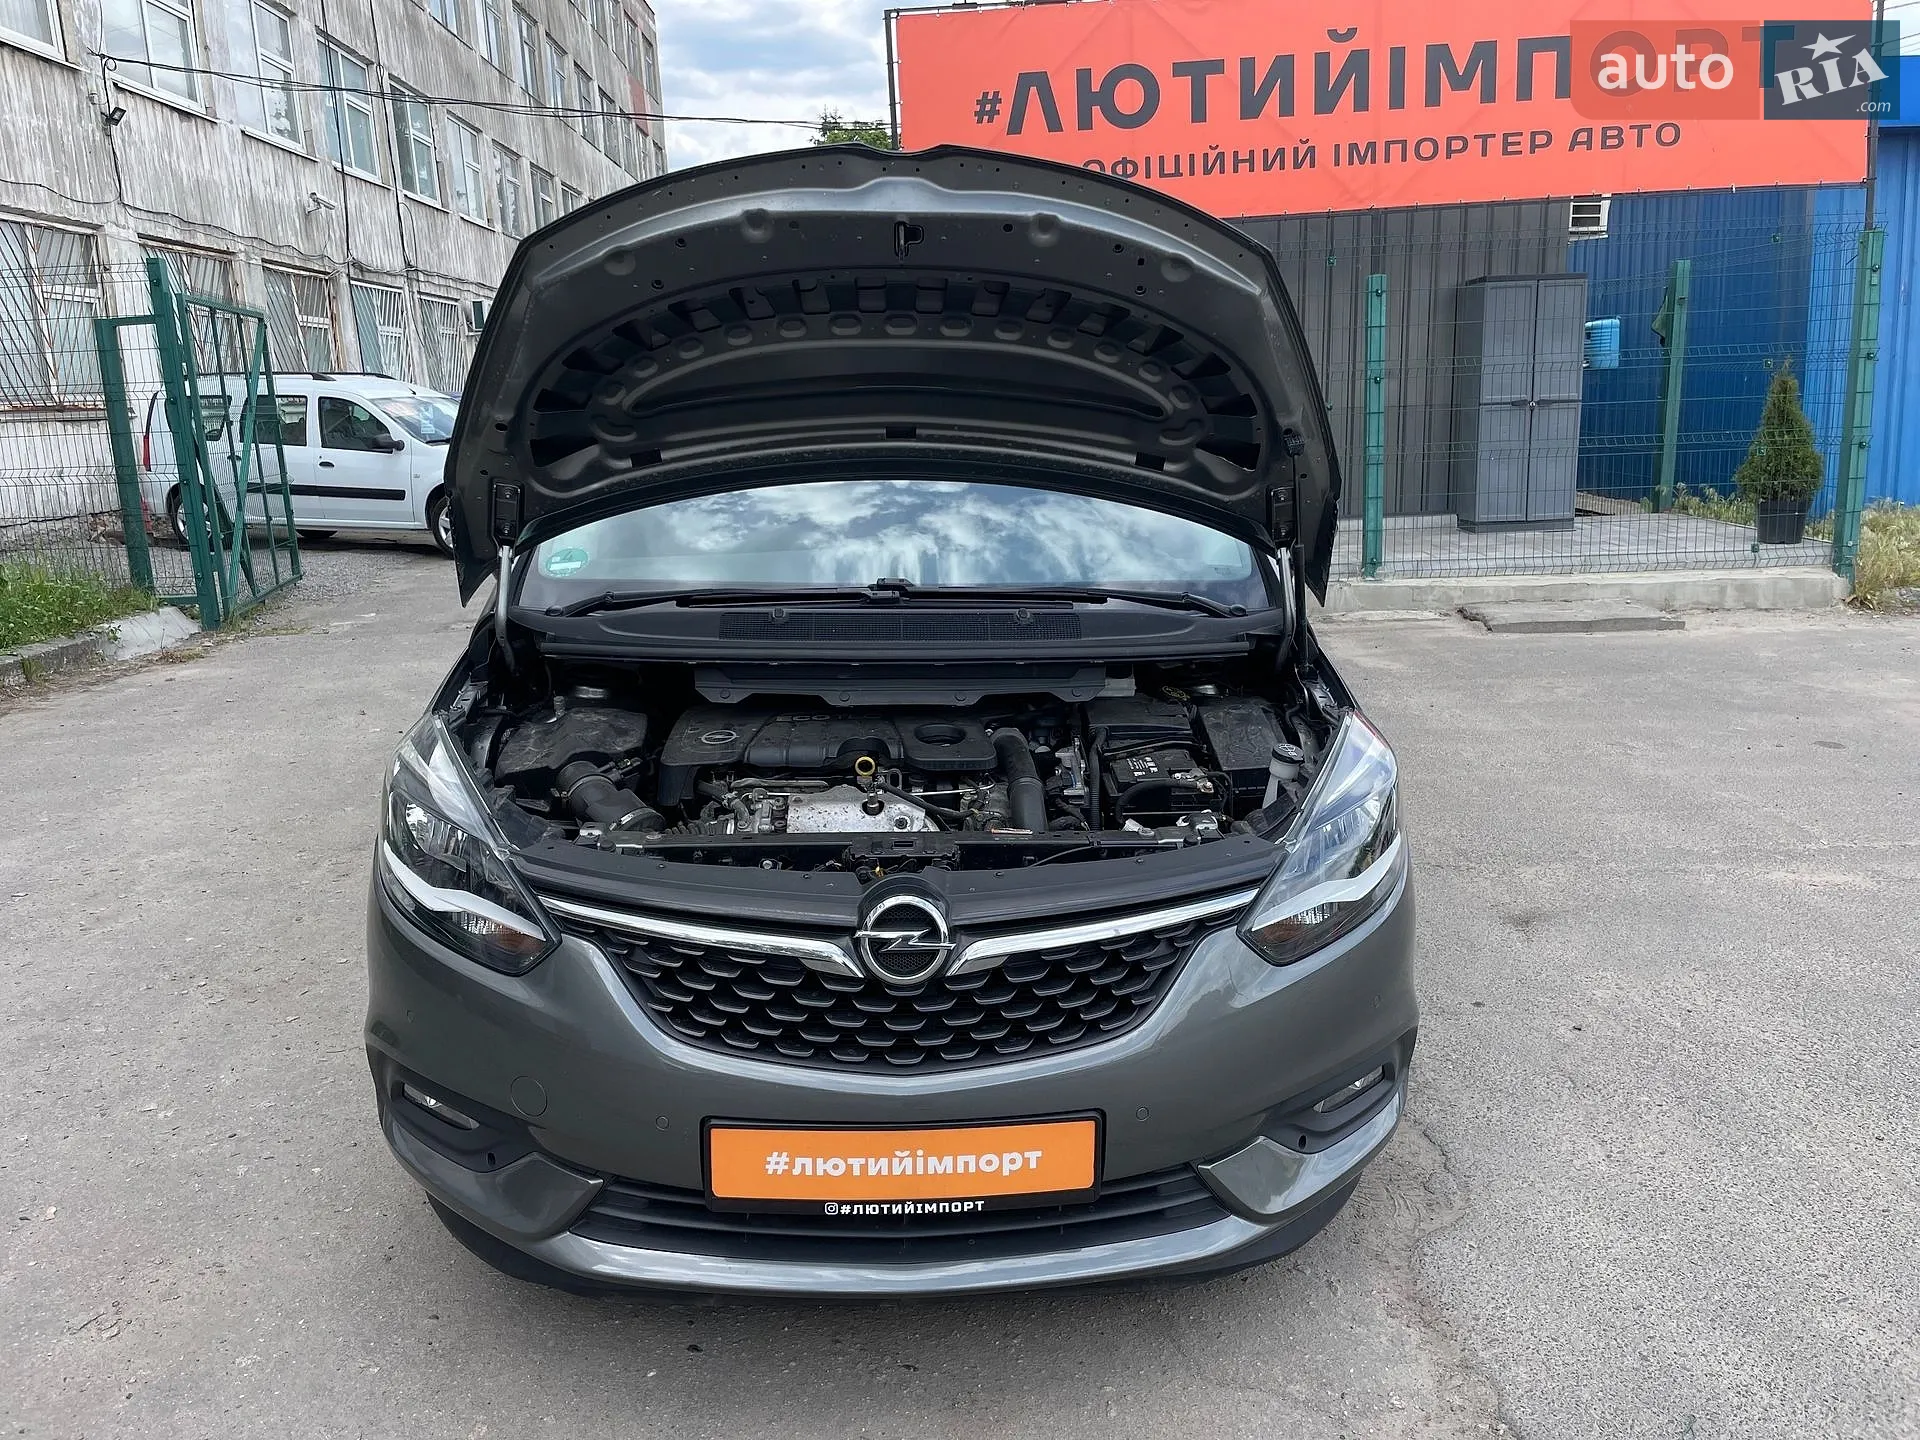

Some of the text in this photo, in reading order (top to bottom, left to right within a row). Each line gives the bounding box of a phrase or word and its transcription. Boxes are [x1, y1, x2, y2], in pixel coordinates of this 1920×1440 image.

[1332, 129, 1553, 168] ІМПОРТЕР
[1568, 122, 1681, 152] АВТО
[764, 1149, 1043, 1177] #лютийімпорт
[839, 1200, 985, 1215] #ЛЮТИЙІМПОРТ
